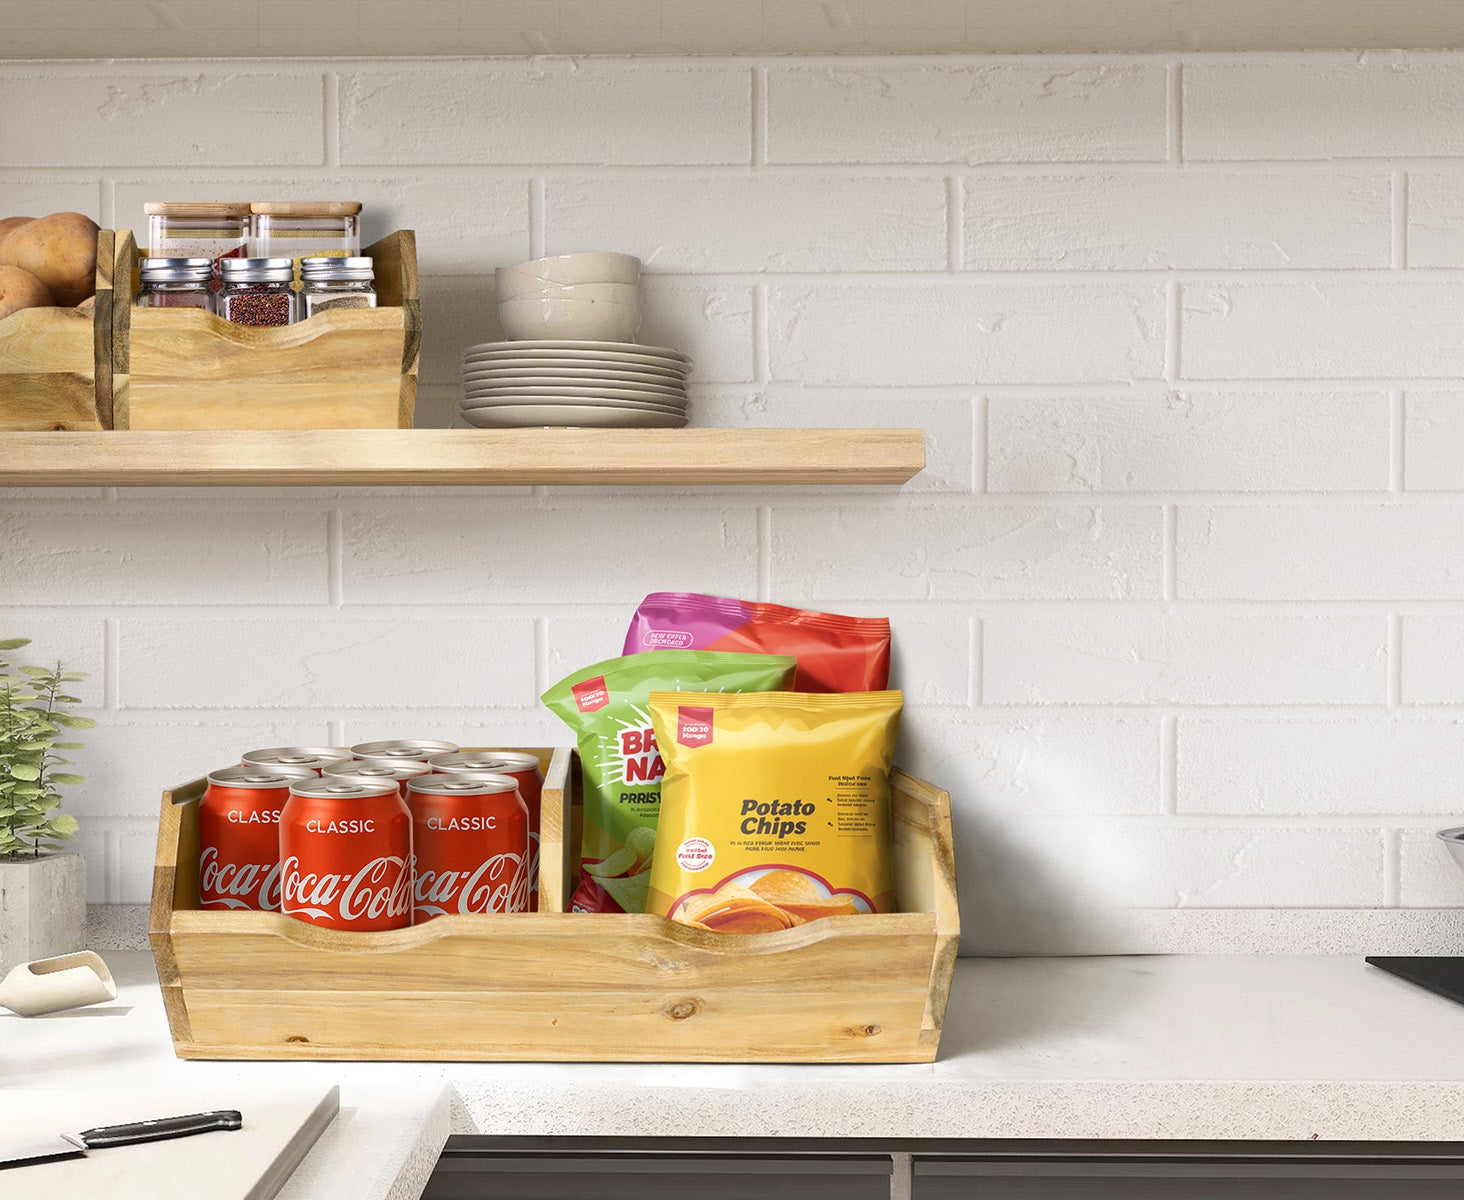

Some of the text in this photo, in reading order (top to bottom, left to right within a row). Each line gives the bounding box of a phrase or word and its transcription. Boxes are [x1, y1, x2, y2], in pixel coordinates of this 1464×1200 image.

[740, 799, 816, 816] Potato
[306, 819, 375, 834] CLASSIC
[426, 815, 497, 831] CLASSIC
[740, 817, 807, 839] Chips
[280, 853, 412, 921] Coca-Cola
